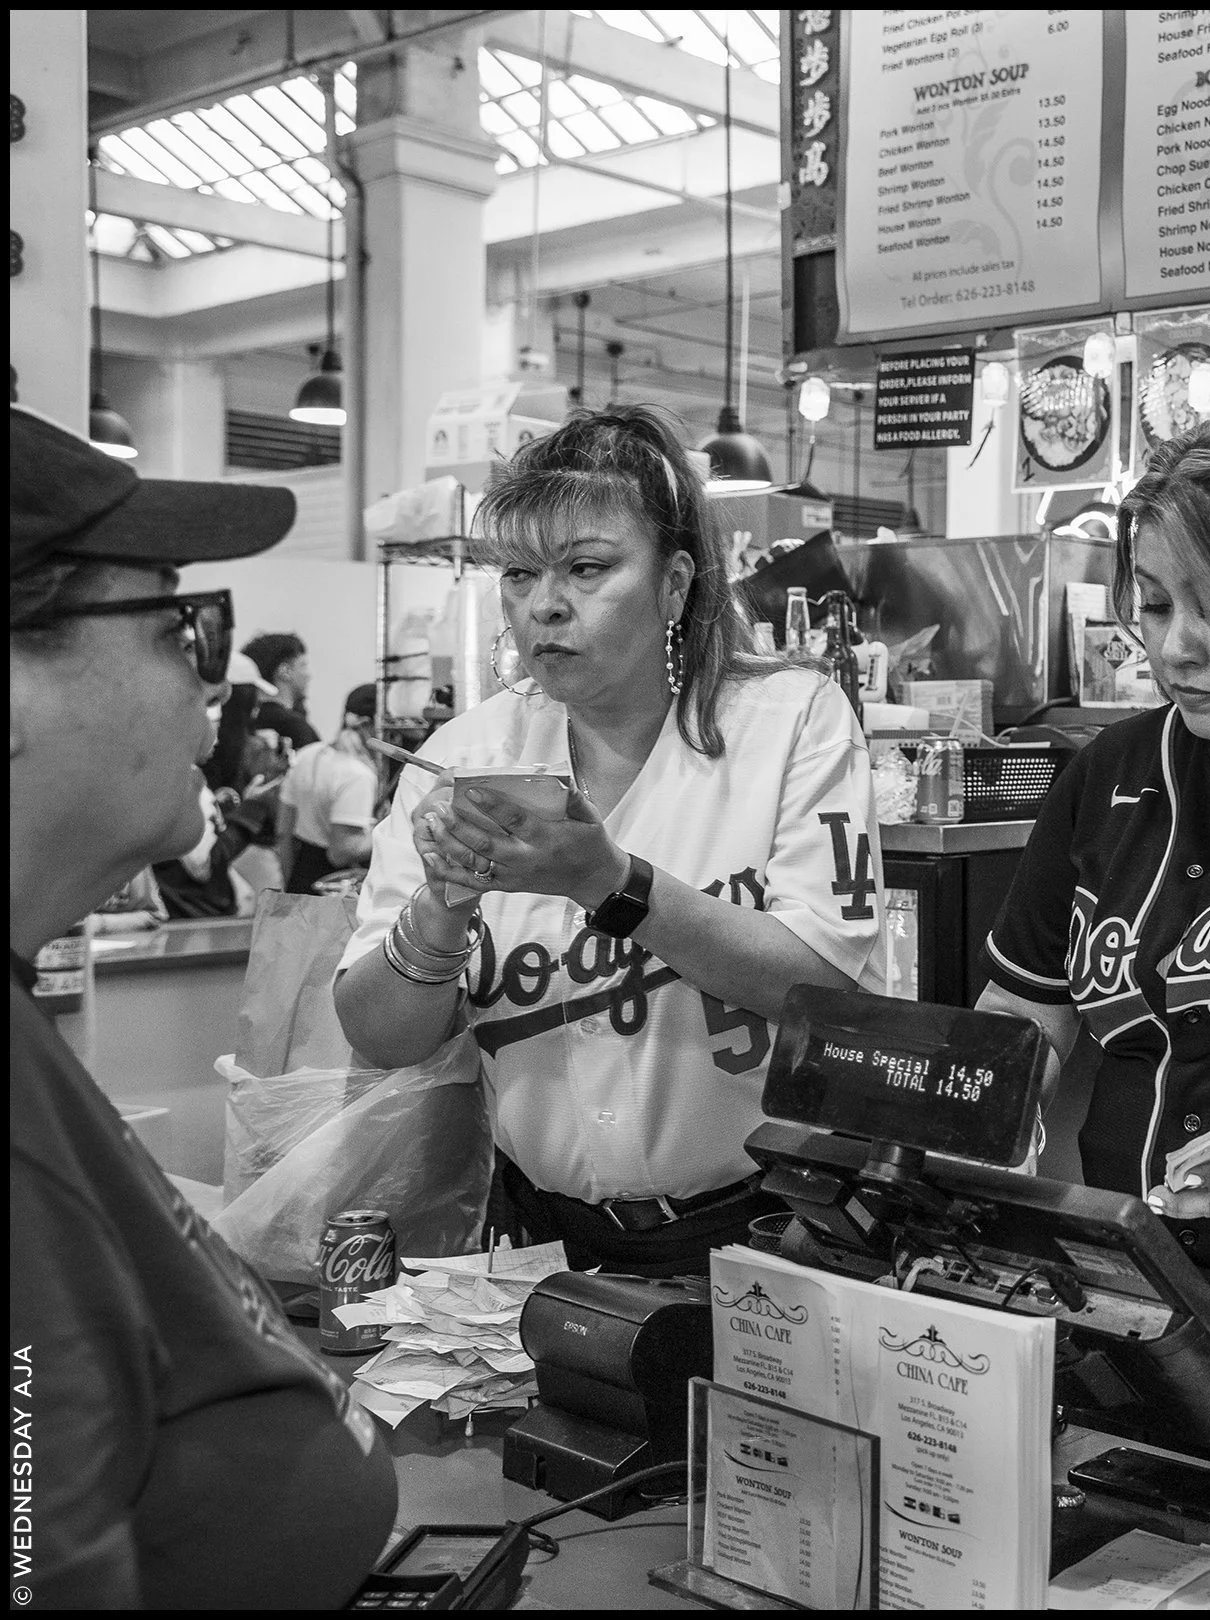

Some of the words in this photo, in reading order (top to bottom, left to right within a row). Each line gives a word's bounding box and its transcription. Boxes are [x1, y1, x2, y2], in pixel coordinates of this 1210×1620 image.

[882, 37, 927, 54] Vegetarian
[930, 32, 948, 44] Egg
[951, 26, 968, 36] Roll
[1158, 29, 1194, 43] House
[1158, 45, 1203, 63] Seafood
[914, 72, 987, 102] WONTON
[989, 63, 1029, 85] SOUP
[880, 128, 898, 138] Pork
[901, 120, 934, 134] Wonton
[1039, 95, 1066, 108] 13.50
[1157, 104, 1178, 117] Egg
[1157, 121, 1201, 136] Chicken
[1157, 143, 1181, 156] Pork
[1156, 164, 1186, 177] Chop
[1157, 182, 1201, 197] Chicken
[1158, 203, 1185, 218] Fried
[1158, 224, 1197, 238] Shrimp
[1160, 245, 1194, 258] House
[1160, 262, 1205, 278] Seafood
[900, 295, 916, 309] Tel
[918, 292, 953, 307] Order:
[955, 280, 1036, 302] 626-223-8148
[881, 360, 909, 372] BEFORE
[910, 357, 945, 369] PLACING
[946, 355, 970, 367] YOUR
[899, 430, 920, 441] FOOD
[818, 811, 876, 920] LA
[824, 1042, 863, 1063] House
[872, 1052, 929, 1075] Special
[949, 1066, 993, 1086] 14.50
[887, 1070, 925, 1091] TOTAL
[936, 1080, 981, 1101] 14.50
[564, 1321, 589, 1336] EPSON
[730, 1316, 762, 1337] CHINA
[765, 1325, 792, 1344] CAFE
[897, 1361, 934, 1385] CHINA
[938, 1373, 968, 1395] CAFE
[743, 1381, 787, 1399] 626-223-8148
[907, 1432, 958, 1453] 626-223-8148
[735, 1475, 772, 1494] WONTON
[773, 1487, 792, 1499] SOUP
[899, 1530, 939, 1553] WONTON
[941, 1545, 962, 1559] SOUP
